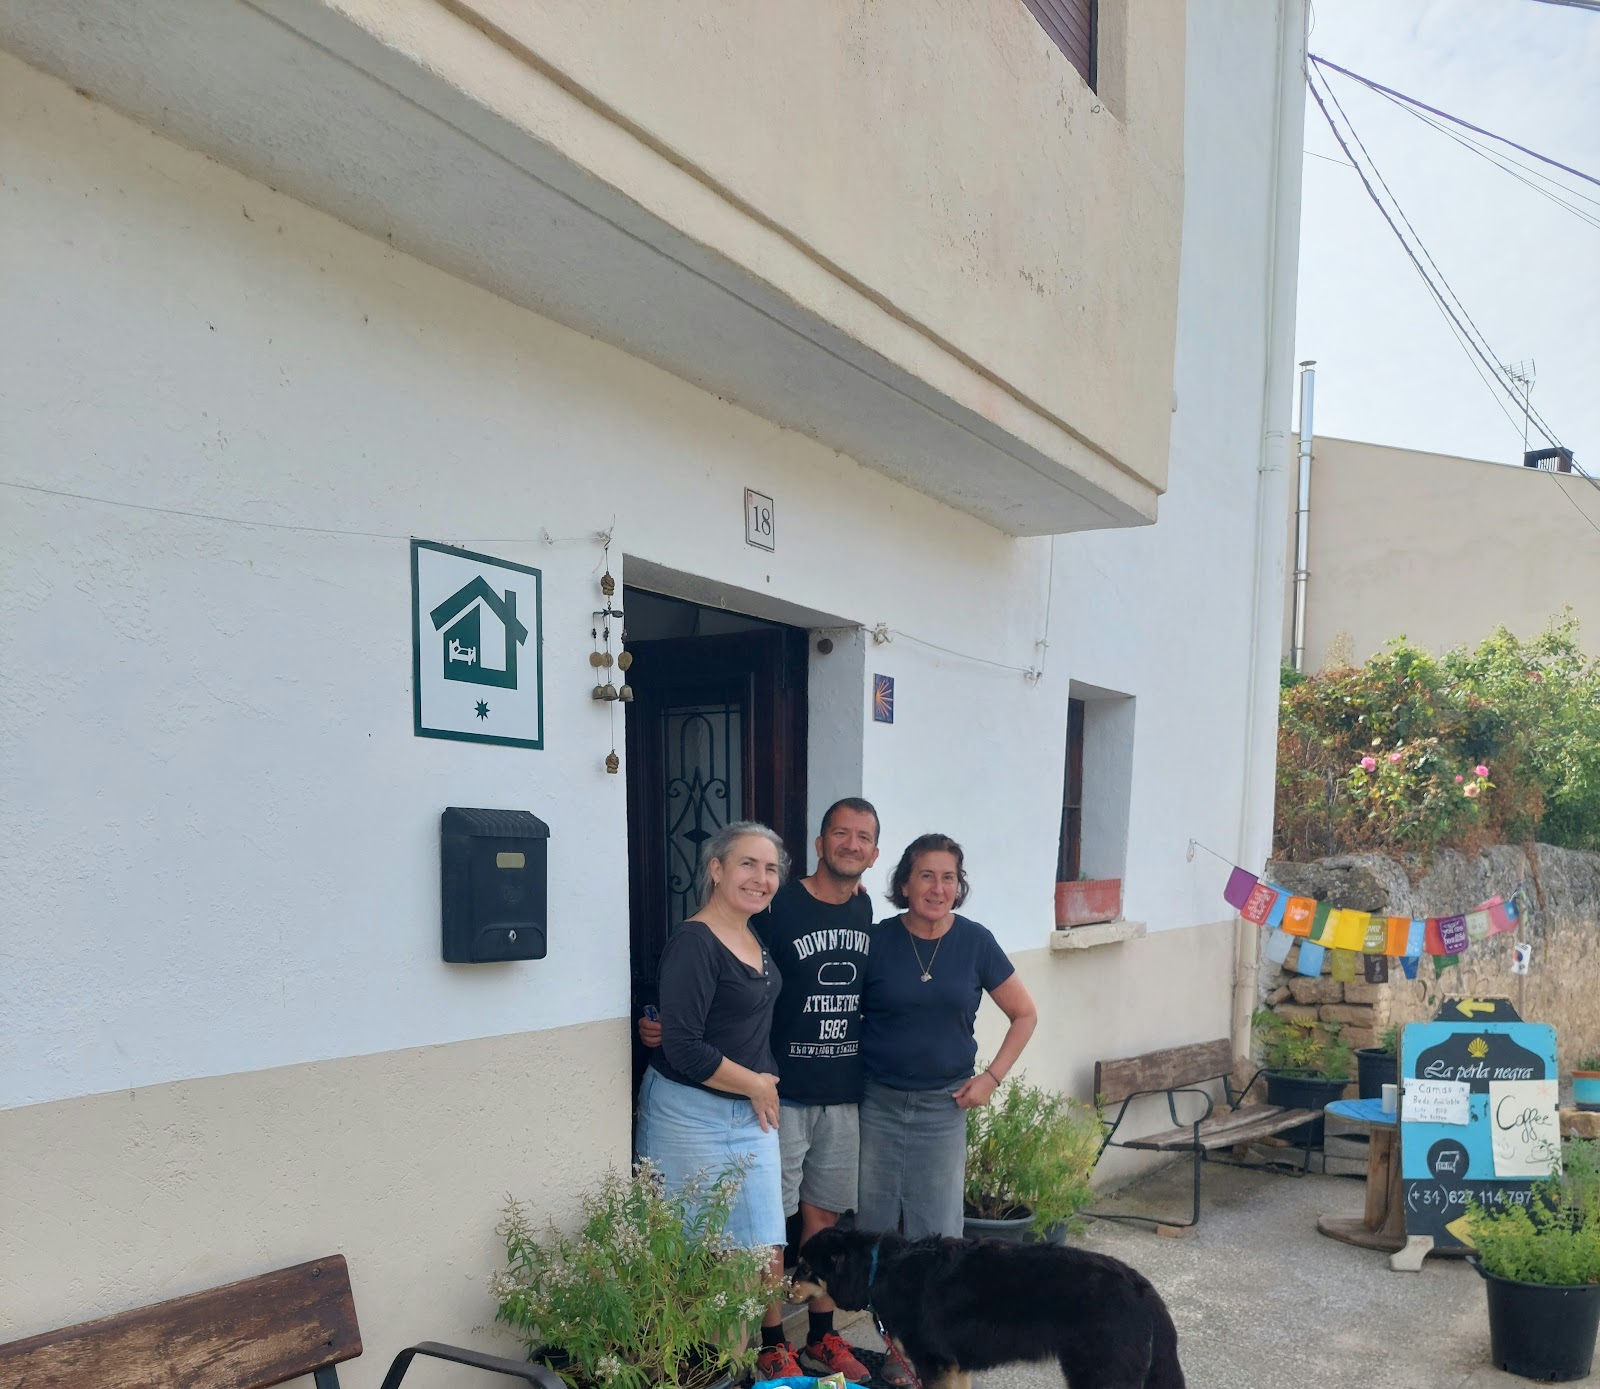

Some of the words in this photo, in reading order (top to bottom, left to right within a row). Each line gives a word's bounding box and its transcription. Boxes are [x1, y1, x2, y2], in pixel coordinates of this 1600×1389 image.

[753, 505, 771, 536] 18
[792, 929, 871, 960] DOWNTOWN
[802, 994, 860, 1013] ATHLETICS
[819, 1019, 848, 1040] 1983
[1423, 1060, 1454, 1078] La
[1493, 1066, 1534, 1081] negra
[1418, 1083, 1452, 1094] Camas
[1496, 1095, 1552, 1143] Coffee
[1479, 1191, 1502, 1204] 114
[1507, 1190, 1532, 1205] 797
